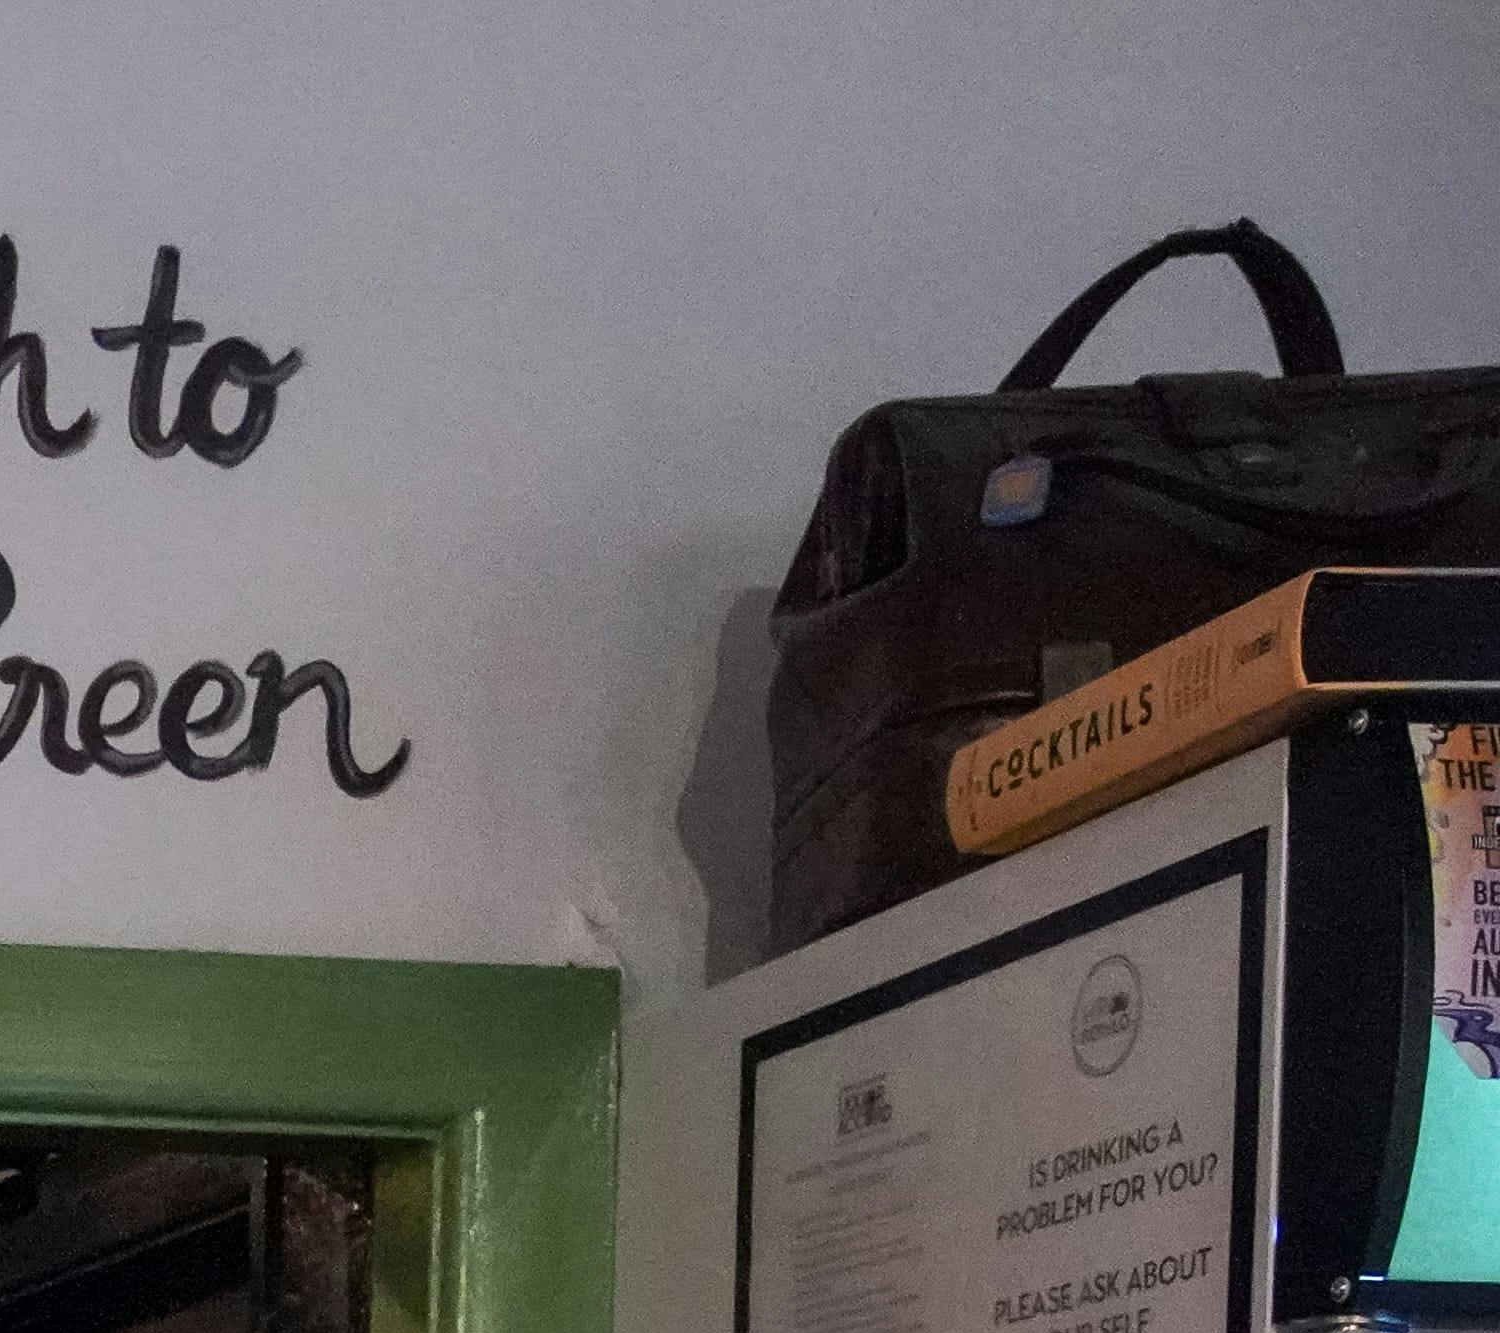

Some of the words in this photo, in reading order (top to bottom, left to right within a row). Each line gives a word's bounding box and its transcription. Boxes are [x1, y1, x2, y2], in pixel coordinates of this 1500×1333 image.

[92, 244, 303, 467] to
[987, 682, 1154, 799] COCKTAILS
[1439, 759, 1496, 792] THE
[1028, 1160, 1048, 1188] IS
[1052, 1124, 1160, 1183] DRINKING
[1167, 1120, 1184, 1146] A
[996, 1190, 1093, 1240] PROBLEM
[1099, 1174, 1146, 1213] FOR
[1153, 1152, 1219, 1196] YOU?
[994, 1282, 1073, 1325] PLEASE
[1079, 1269, 1121, 1304] ASK
[1129, 1247, 1213, 1292] ABOUT
